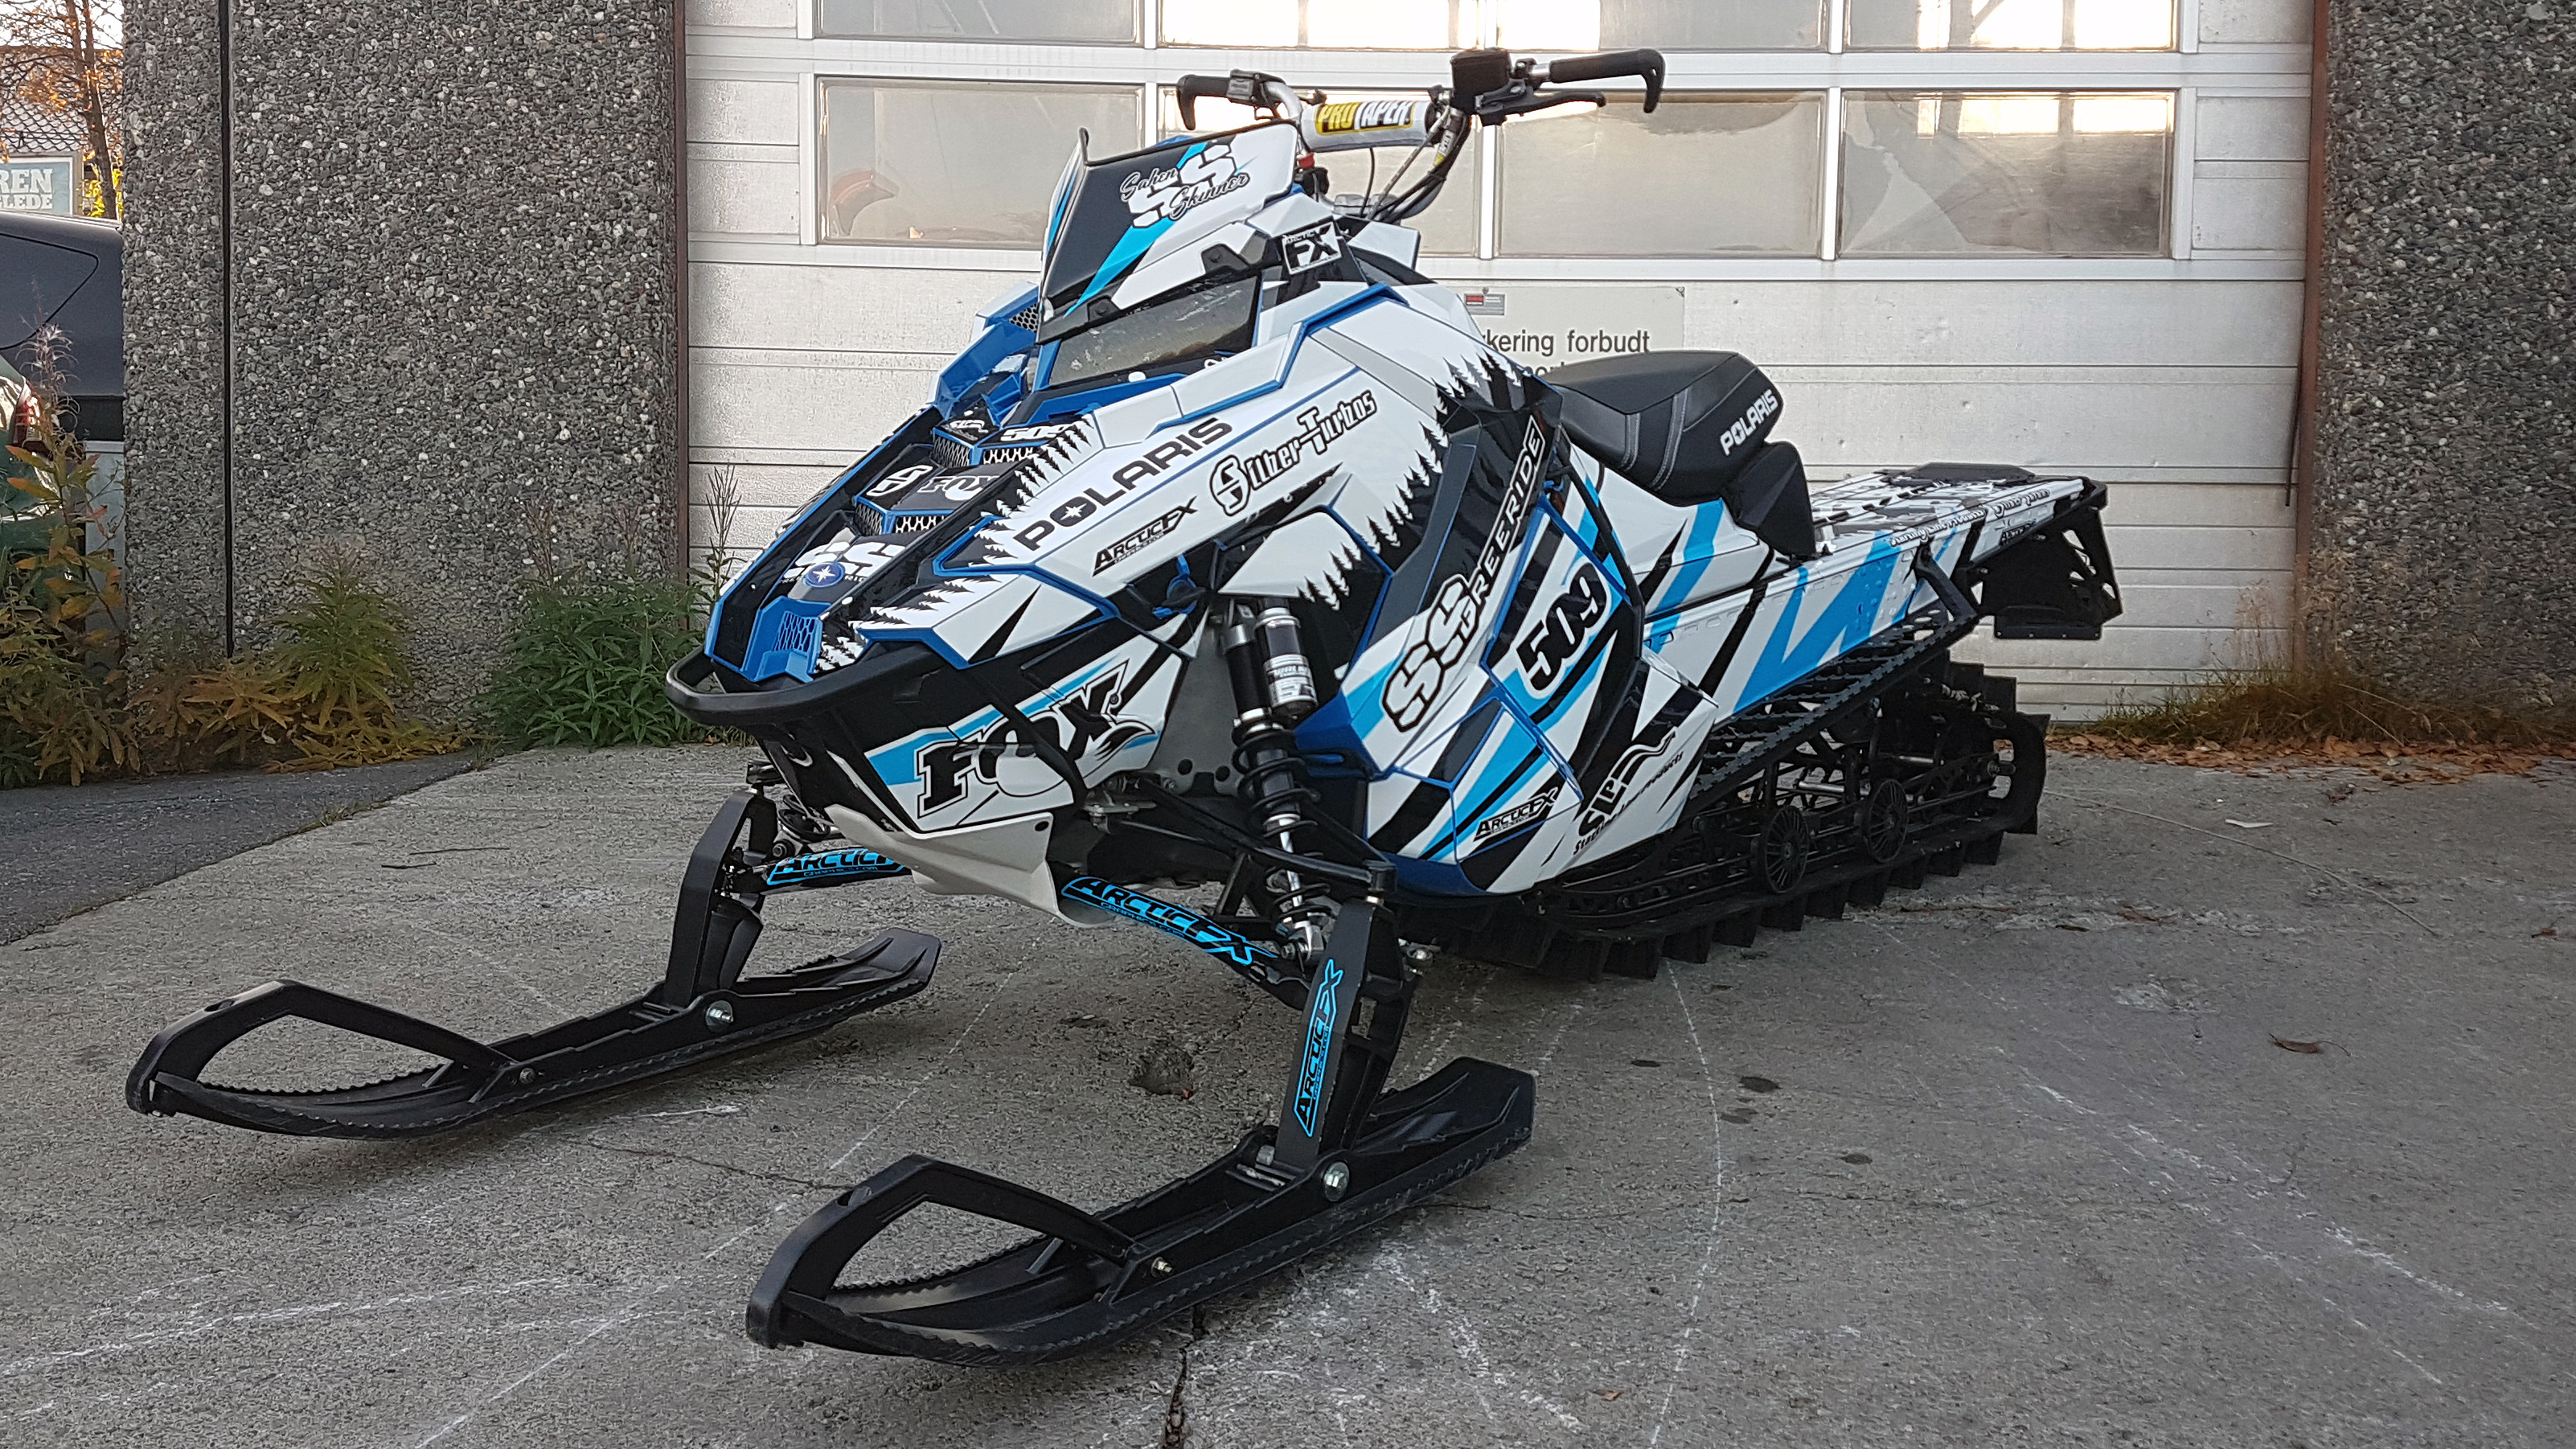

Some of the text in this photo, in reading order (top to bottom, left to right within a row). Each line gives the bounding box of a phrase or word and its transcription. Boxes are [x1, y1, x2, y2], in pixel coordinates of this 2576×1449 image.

[0, 194, 53, 209] LEDE
[1169, 173, 1250, 220] Skinner
[1483, 330, 1650, 356] kering forbudt
[1721, 389, 1778, 455] POLARIS
[1013, 417, 1233, 551] POLARIS
[1457, 428, 1540, 638] FREERIDE
[1516, 564, 1607, 692] 509
[917, 659, 1153, 819] FOX
